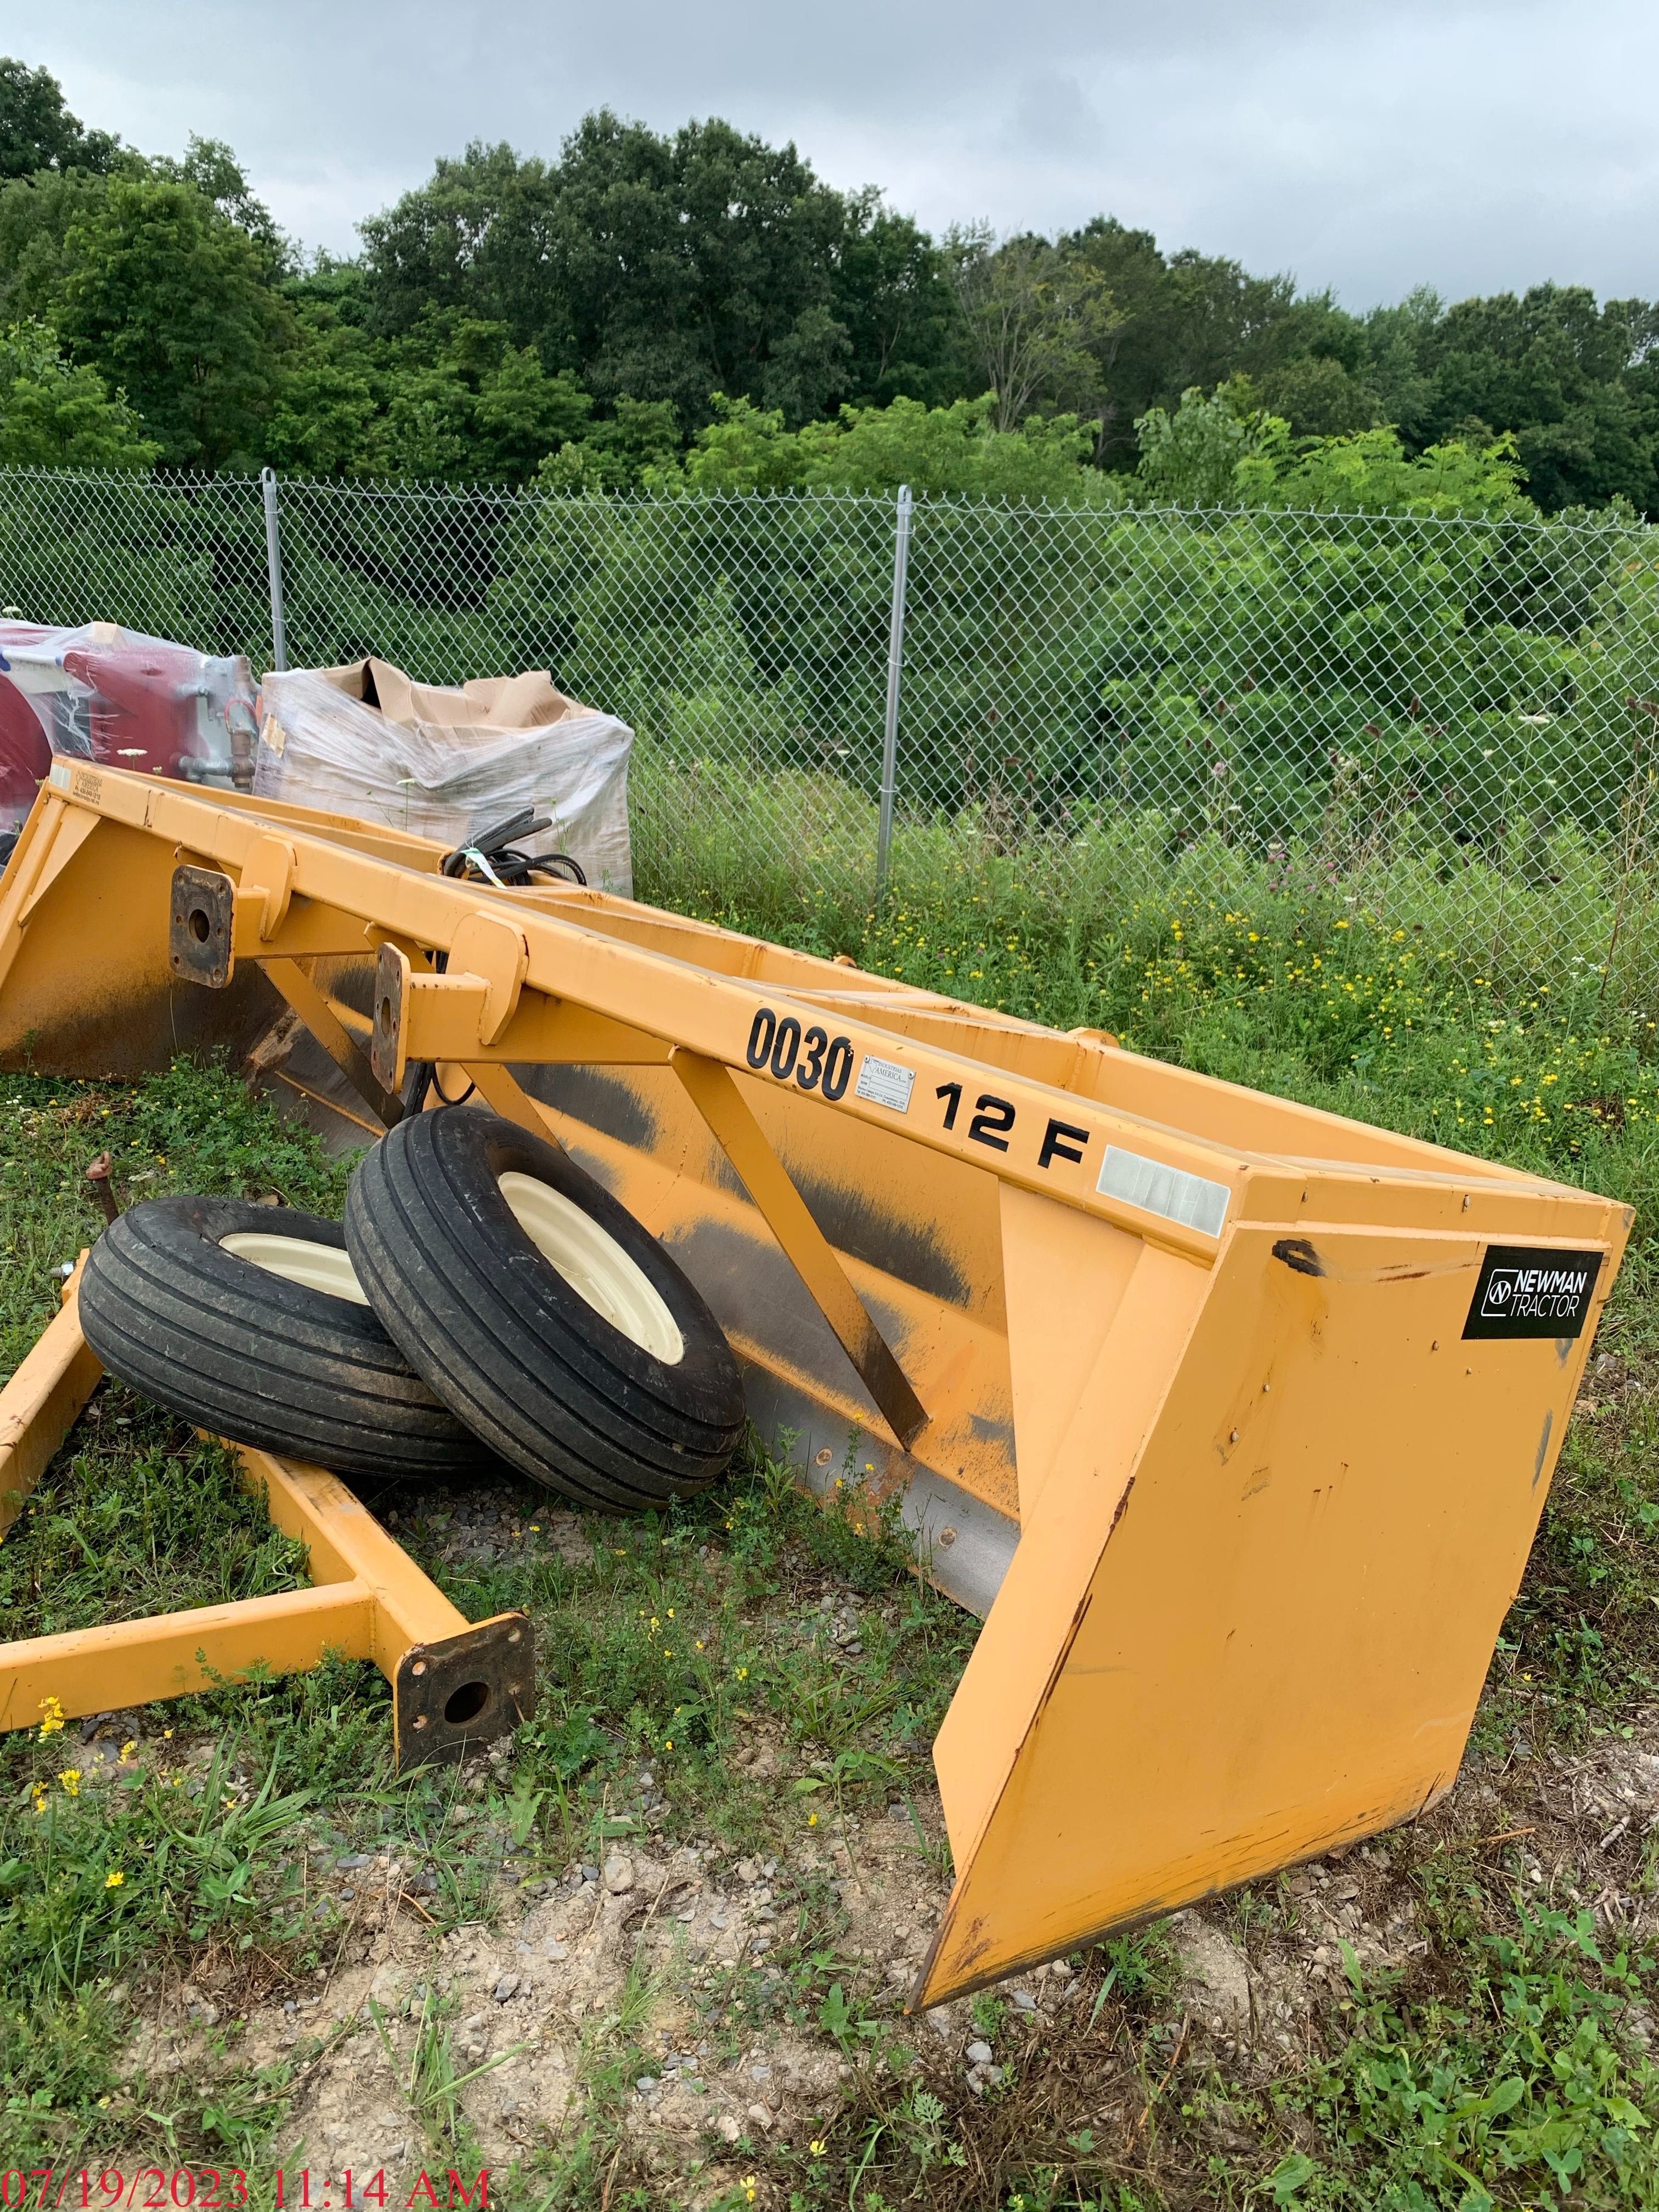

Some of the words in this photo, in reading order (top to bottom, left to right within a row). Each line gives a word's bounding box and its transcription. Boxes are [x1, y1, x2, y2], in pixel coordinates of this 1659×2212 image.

[747, 1008, 854, 1101] 0030
[878, 1062, 902, 1074] INDUSTRIAS
[935, 1082, 1015, 1153] 12
[1037, 1118, 1090, 1169] F
[1514, 1269, 1588, 1294] NEWMAN
[1510, 1294, 1580, 1317] TRACTOR
